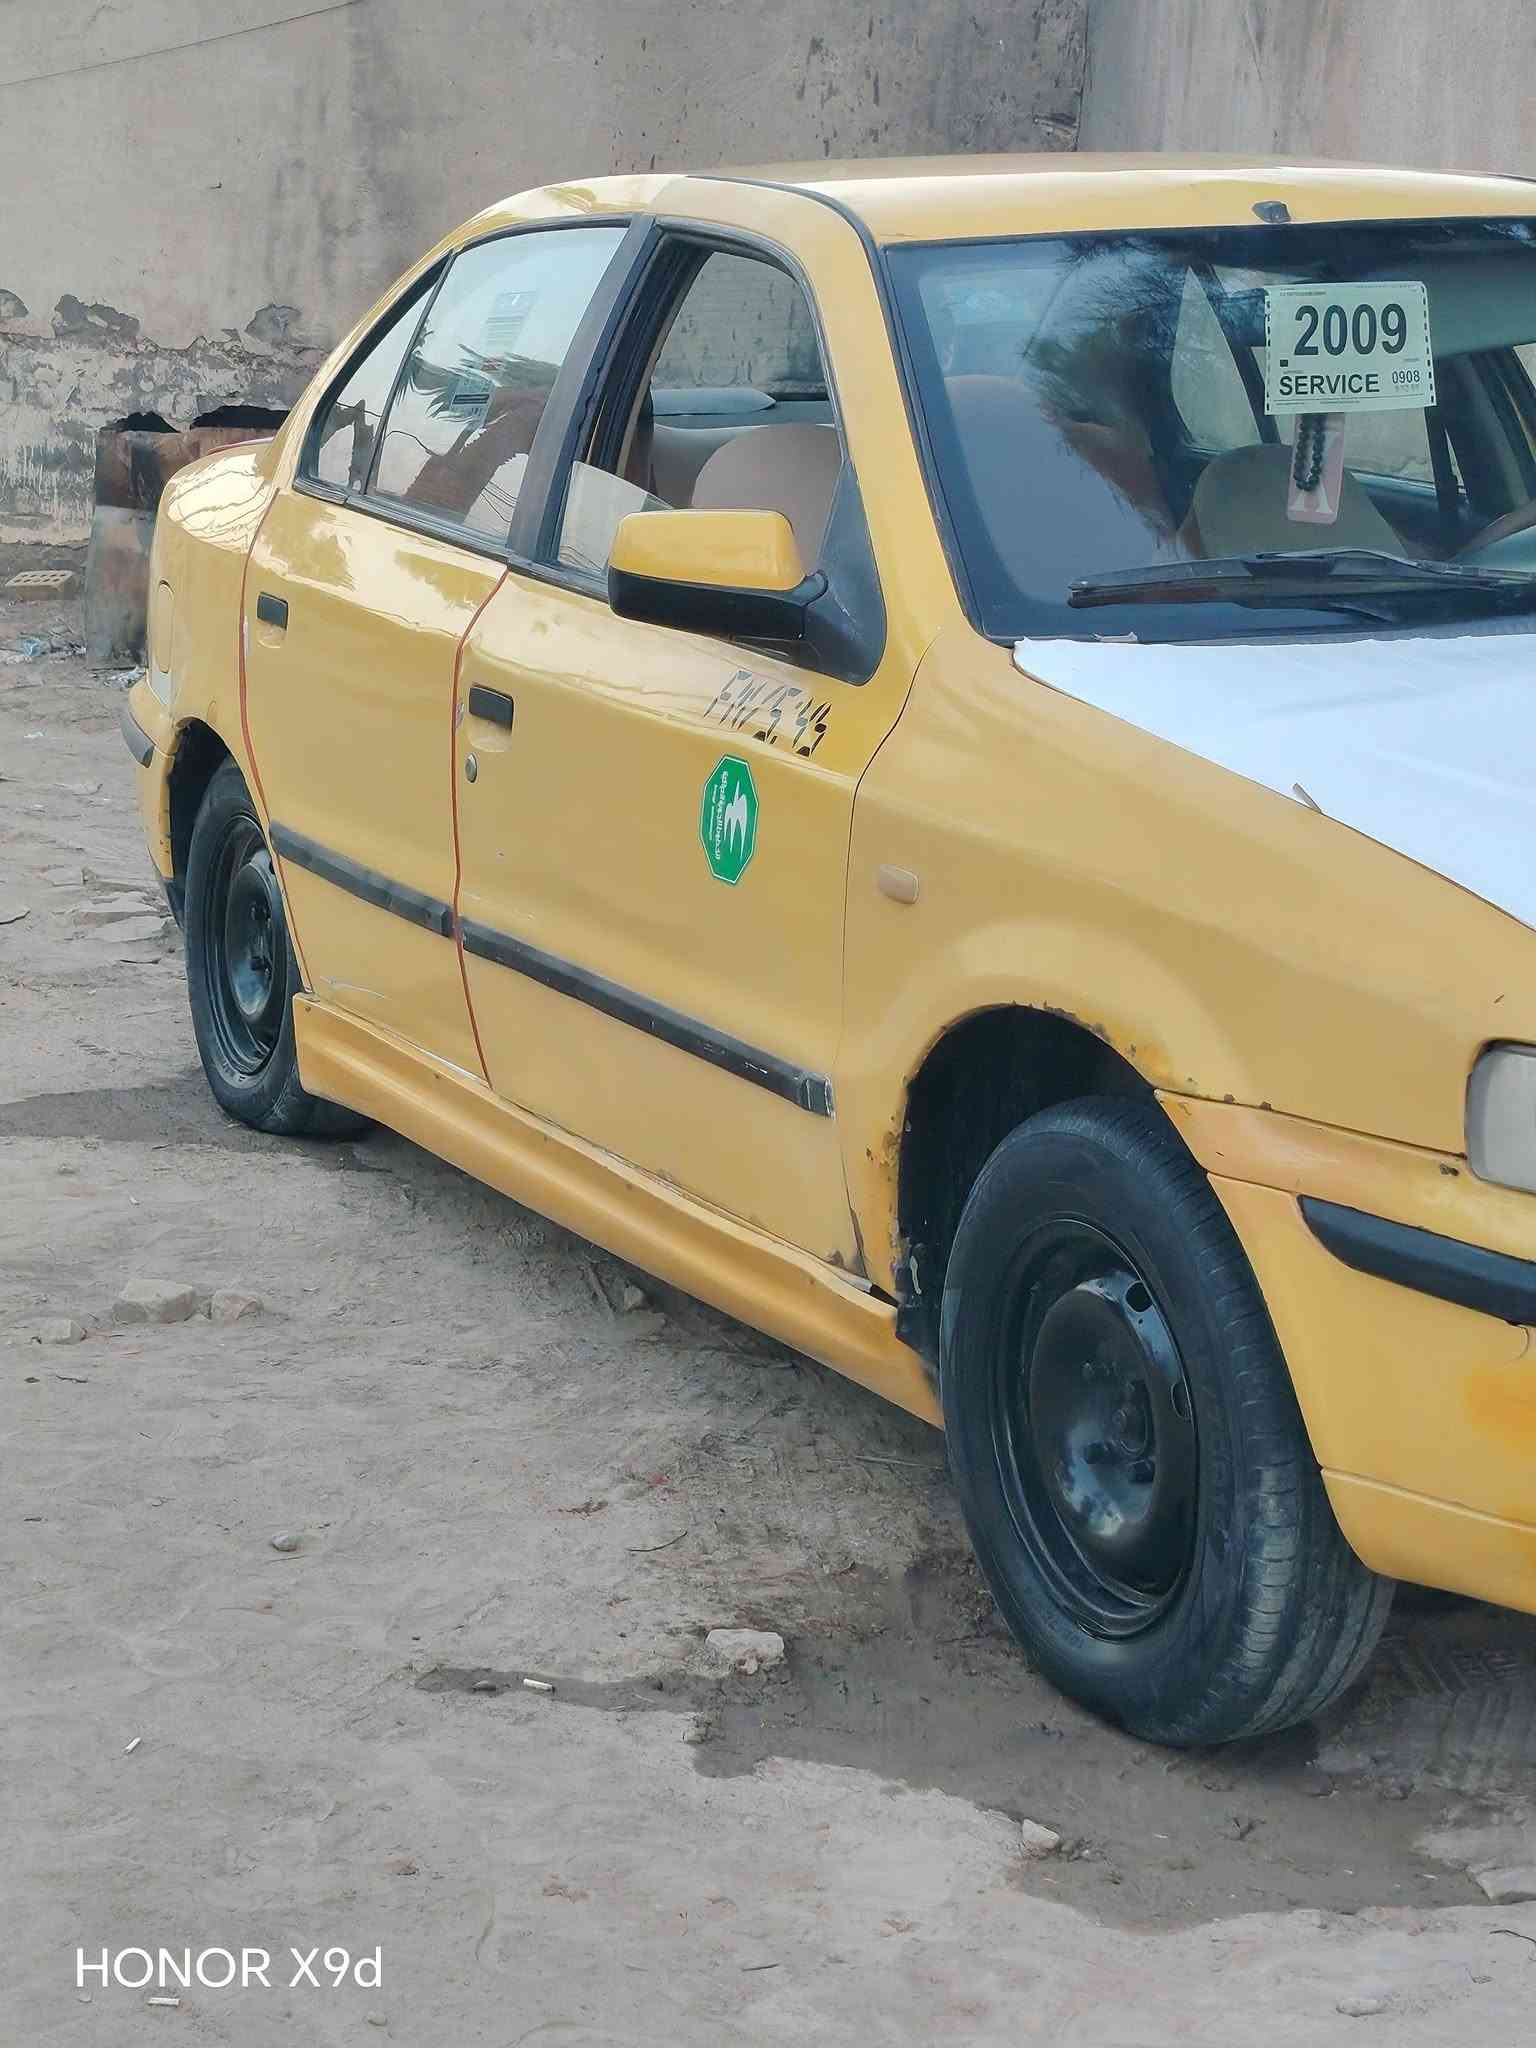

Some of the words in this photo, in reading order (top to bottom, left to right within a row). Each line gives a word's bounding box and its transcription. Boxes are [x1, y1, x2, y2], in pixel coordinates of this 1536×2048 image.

[1294, 303, 1407, 356] 2009
[1279, 373, 1380, 396] SERVICE
[1391, 370, 1421, 385] 0908
